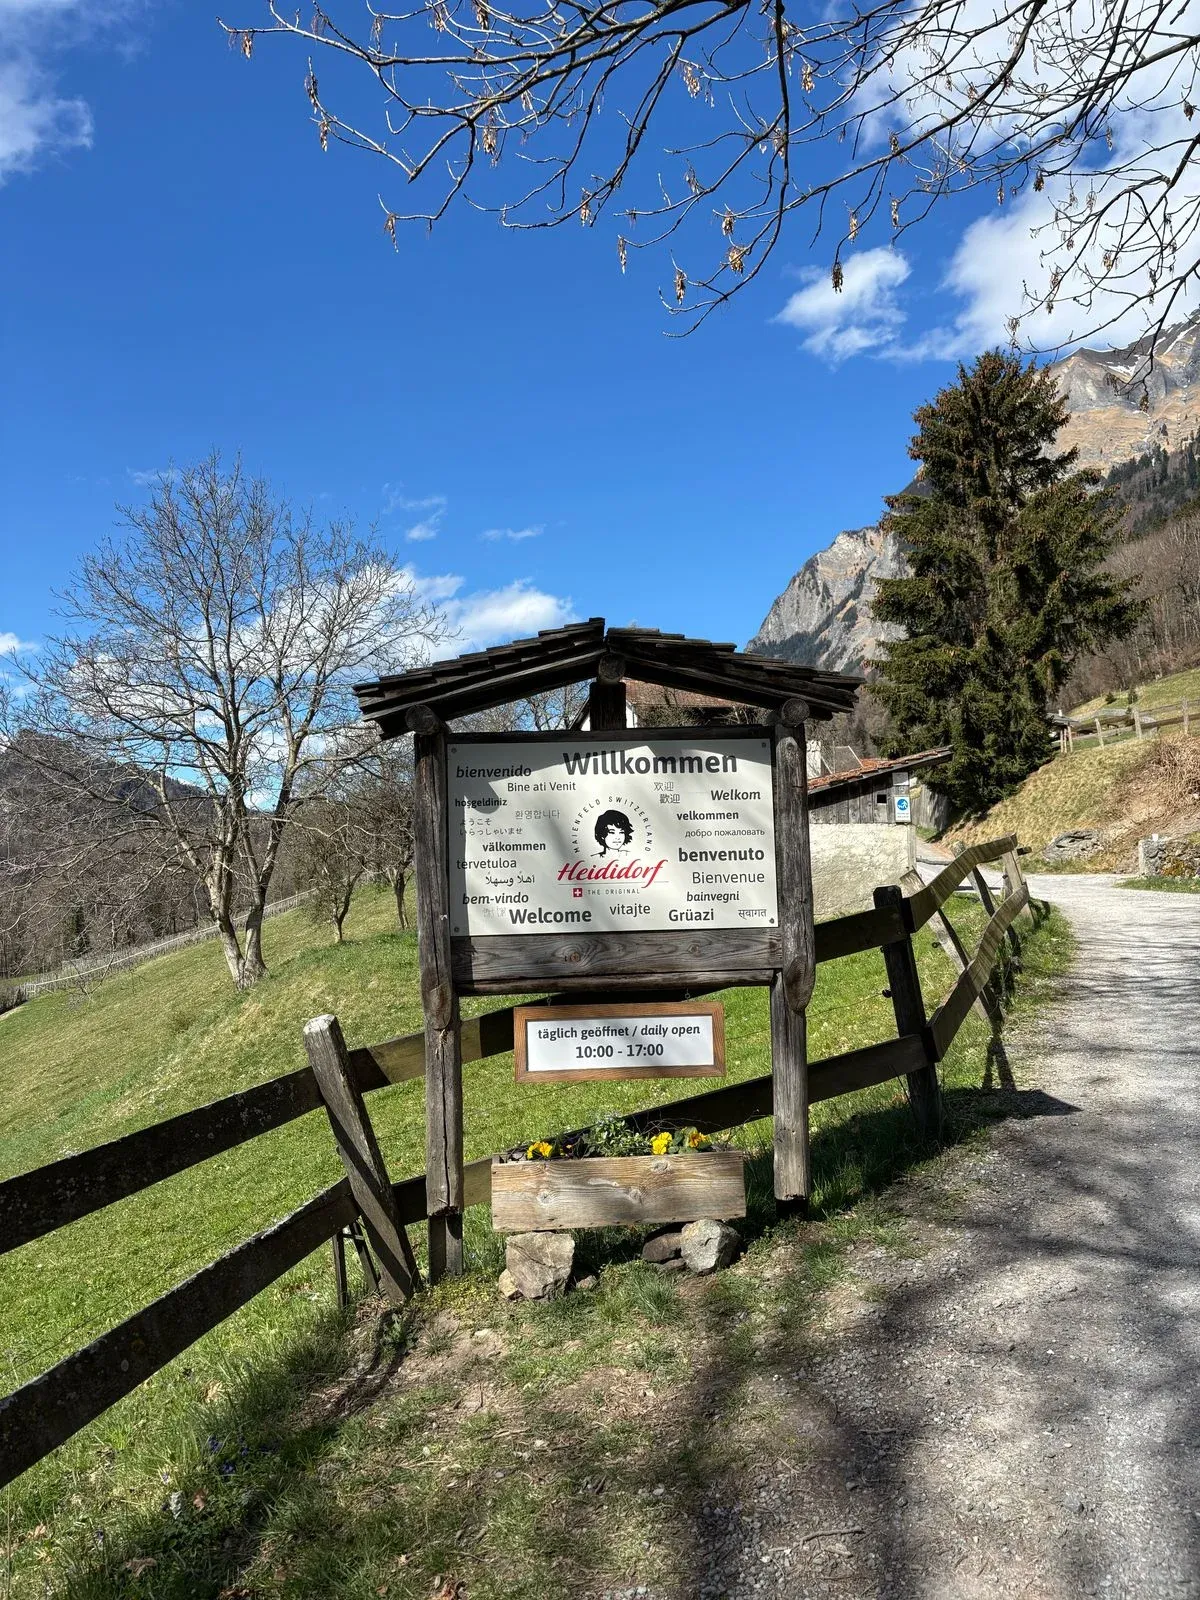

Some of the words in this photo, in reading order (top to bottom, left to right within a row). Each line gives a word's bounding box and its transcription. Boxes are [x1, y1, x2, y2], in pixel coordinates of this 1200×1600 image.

[562, 750, 738, 776] Willkommen
[456, 765, 532, 778] bienvenido
[507, 783, 530, 792] Bine
[533, 782, 547, 792] ati
[549, 781, 577, 791] Venit
[654, 781, 674, 791] 欢迎
[711, 789, 761, 801] Welkom
[455, 798, 508, 809] hoşgeldiniz
[677, 811, 739, 821] velkommen
[572, 798, 601, 854] MAIENFELD
[608, 796, 653, 852] SWITZERLAND
[685, 829, 712, 839] добро
[714, 829, 765, 838] пожаловать
[482, 841, 546, 852] välkommen
[679, 847, 765, 862] benvenuto
[456, 857, 517, 870] tervetuloa
[557, 859, 669, 889] Heididorf
[692, 871, 765, 884] Bienvenue
[462, 892, 529, 905] bem-vindo
[605, 888, 640, 896] ORIGINAL
[686, 891, 740, 904] bainvegni
[509, 907, 592, 924] Welcome
[609, 903, 651, 918] vitajte
[668, 908, 715, 922] Grüazi
[538, 1026, 578, 1041] täglich
[580, 1025, 629, 1041] geöffnet
[632, 1024, 637, 1037] /
[640, 1024, 668, 1038] daily
[671, 1025, 701, 1037] open
[575, 1045, 614, 1059] 10:00
[626, 1044, 664, 1057] 17:00
